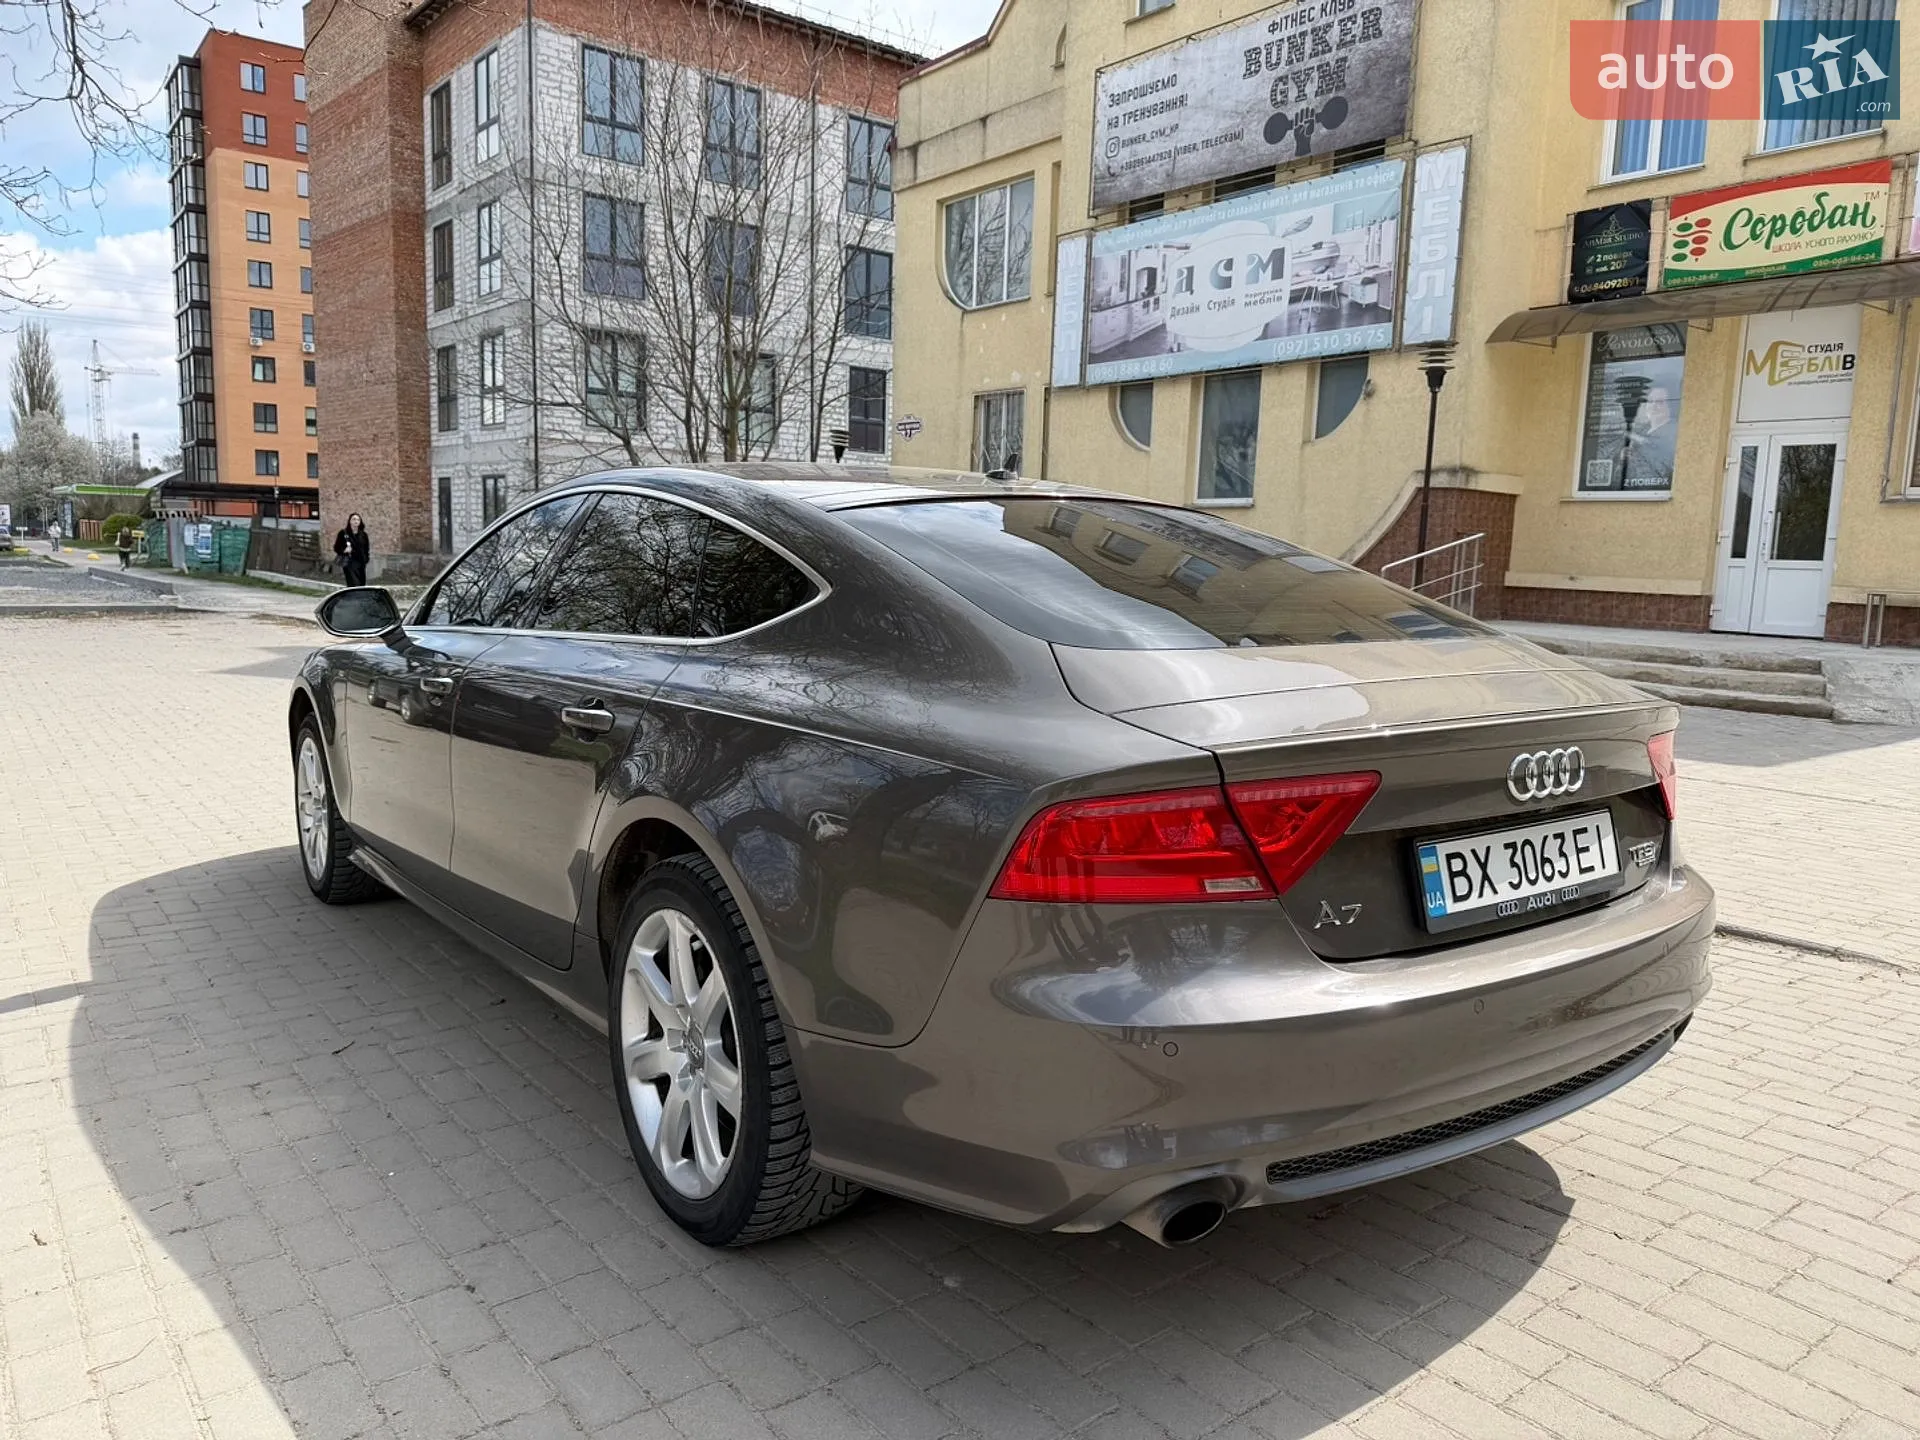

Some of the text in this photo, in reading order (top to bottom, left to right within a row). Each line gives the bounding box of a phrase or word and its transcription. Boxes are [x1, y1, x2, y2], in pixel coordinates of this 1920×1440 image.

[1268, 0, 1354, 35] ФІТНЕС КЛУБ
[1242, 6, 1382, 80] BUNKER
[1270, 55, 1349, 109] GYM
[1723, 191, 1876, 250] Соробан
[1411, 152, 1461, 335] МЕБЛІ
[1772, 230, 1877, 254] ШКОЛА УСНОГО РАХУНКУ
[1207, 296, 1236, 313] Студія
[1312, 334, 1339, 352] 510
[1343, 331, 1360, 347] 36
[1366, 329, 1385, 344] 75
[1807, 342, 1844, 354] СТУДІЯ
[1445, 824, 1606, 903] BX 3063 EI
[1313, 899, 1363, 930] A7
[1427, 891, 1444, 909] UA
[1527, 892, 1556, 911] Audi
